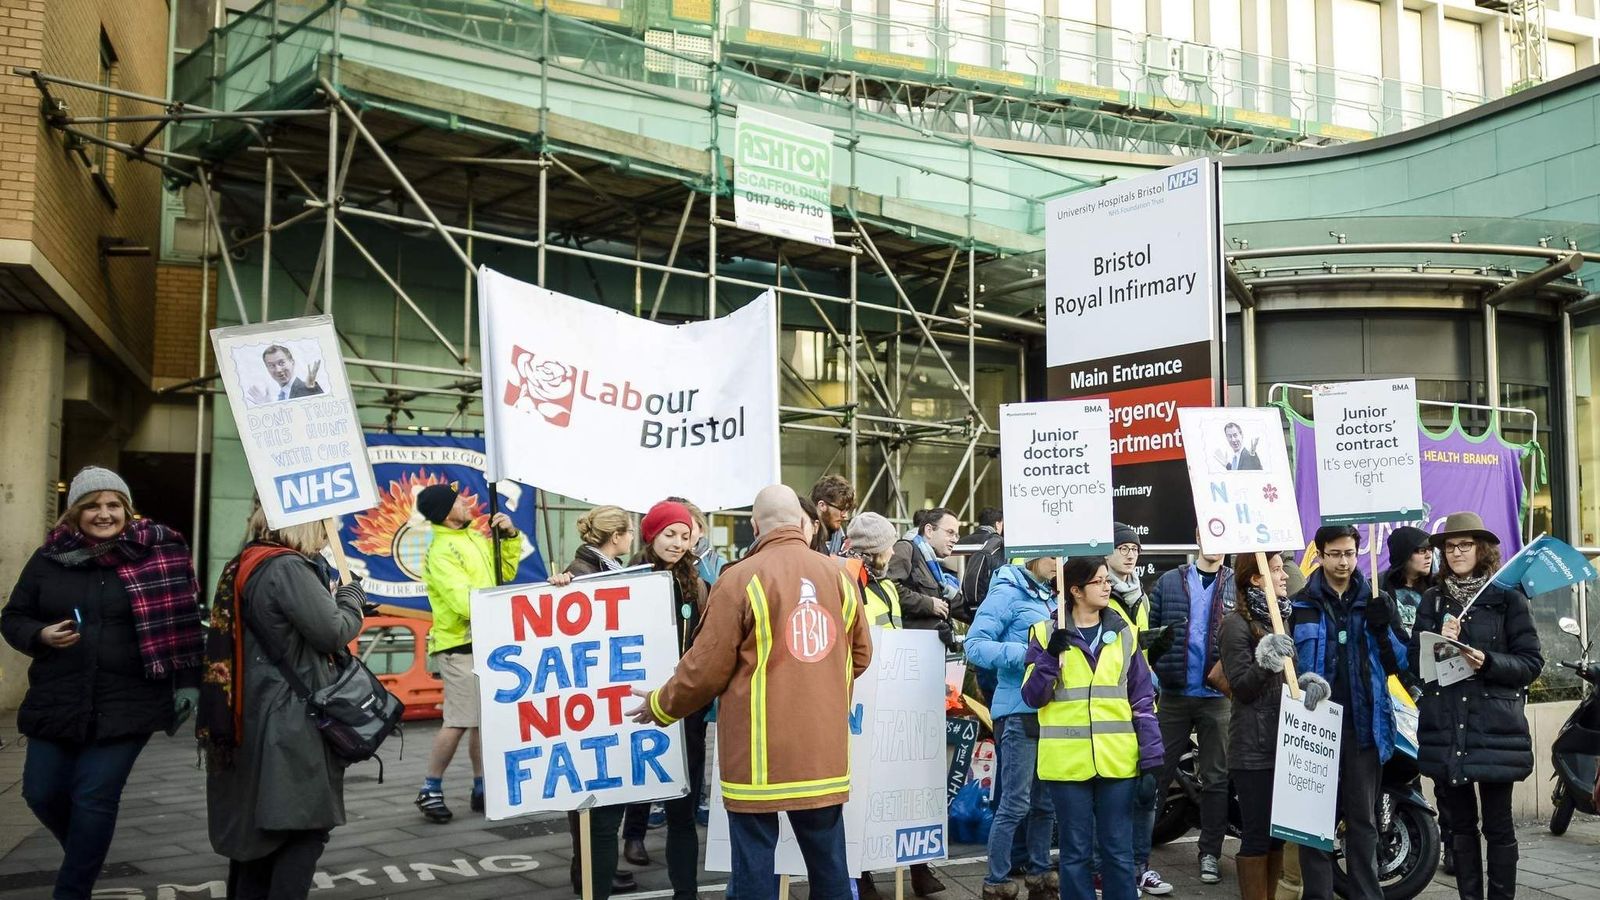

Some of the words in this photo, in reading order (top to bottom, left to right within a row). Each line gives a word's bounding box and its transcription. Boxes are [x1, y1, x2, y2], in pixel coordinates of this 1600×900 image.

[739, 131, 830, 180] ASHTON
[738, 171, 829, 202] SCAFFOLDING
[1057, 202, 1096, 220] University
[1097, 191, 1136, 208] Hospitals
[1137, 182, 1165, 199] Bristol
[1168, 168, 1198, 191] NHS
[746, 191, 771, 206] 0117
[774, 197, 796, 212] 966
[799, 202, 824, 218] 7130
[1108, 208, 1121, 217] NHS
[1121, 201, 1151, 215] Foundation
[1151, 197, 1164, 207] Trust
[1094, 243, 1151, 277] Bristol
[1055, 286, 1102, 316] Royal
[1109, 272, 1197, 305] Infirmary
[1070, 368, 1108, 390] Main
[1112, 358, 1182, 383] Entrance
[579, 370, 700, 416] Labour
[303, 399, 349, 422] TRUST
[1084, 405, 1103, 413] BMA
[1108, 400, 1176, 427] ergency
[1343, 405, 1387, 422] Junior
[252, 427, 293, 450] THIS
[640, 406, 745, 449] Bristol
[1031, 428, 1079, 444] Junior
[1335, 420, 1396, 436] doctors'
[271, 446, 312, 467] WITH
[317, 440, 351, 463] OUR
[1023, 444, 1088, 460] doctors'
[1110, 428, 1182, 454] artment
[1335, 436, 1399, 452] contract
[442, 449, 485, 467] REGIO
[1023, 462, 1090, 477] contract
[1344, 453, 1414, 471] everyone's
[1424, 450, 1460, 463] HEALTH
[1463, 453, 1499, 466] BRANCH
[281, 467, 353, 509] NHS
[1031, 480, 1106, 498] everyone's
[1355, 471, 1384, 487] fight
[1042, 499, 1074, 517] fight
[1147, 563, 1155, 574] &
[511, 586, 630, 641] NOT
[792, 607, 829, 657] FBU
[487, 635, 646, 704] SAFE
[877, 647, 920, 681] WE
[517, 685, 633, 742] NOT
[1329, 707, 1339, 716] BMA
[1284, 711, 1300, 729] We
[1302, 720, 1317, 735] are
[1319, 727, 1337, 742] one
[1283, 733, 1335, 759] profession
[504, 729, 674, 806] FAIR
[1288, 752, 1303, 769] We
[1304, 760, 1328, 777] stand
[1288, 772, 1326, 795] together
[866, 786, 945, 823] GETHER!
[863, 834, 895, 860] UR
[897, 828, 942, 858] NHS
